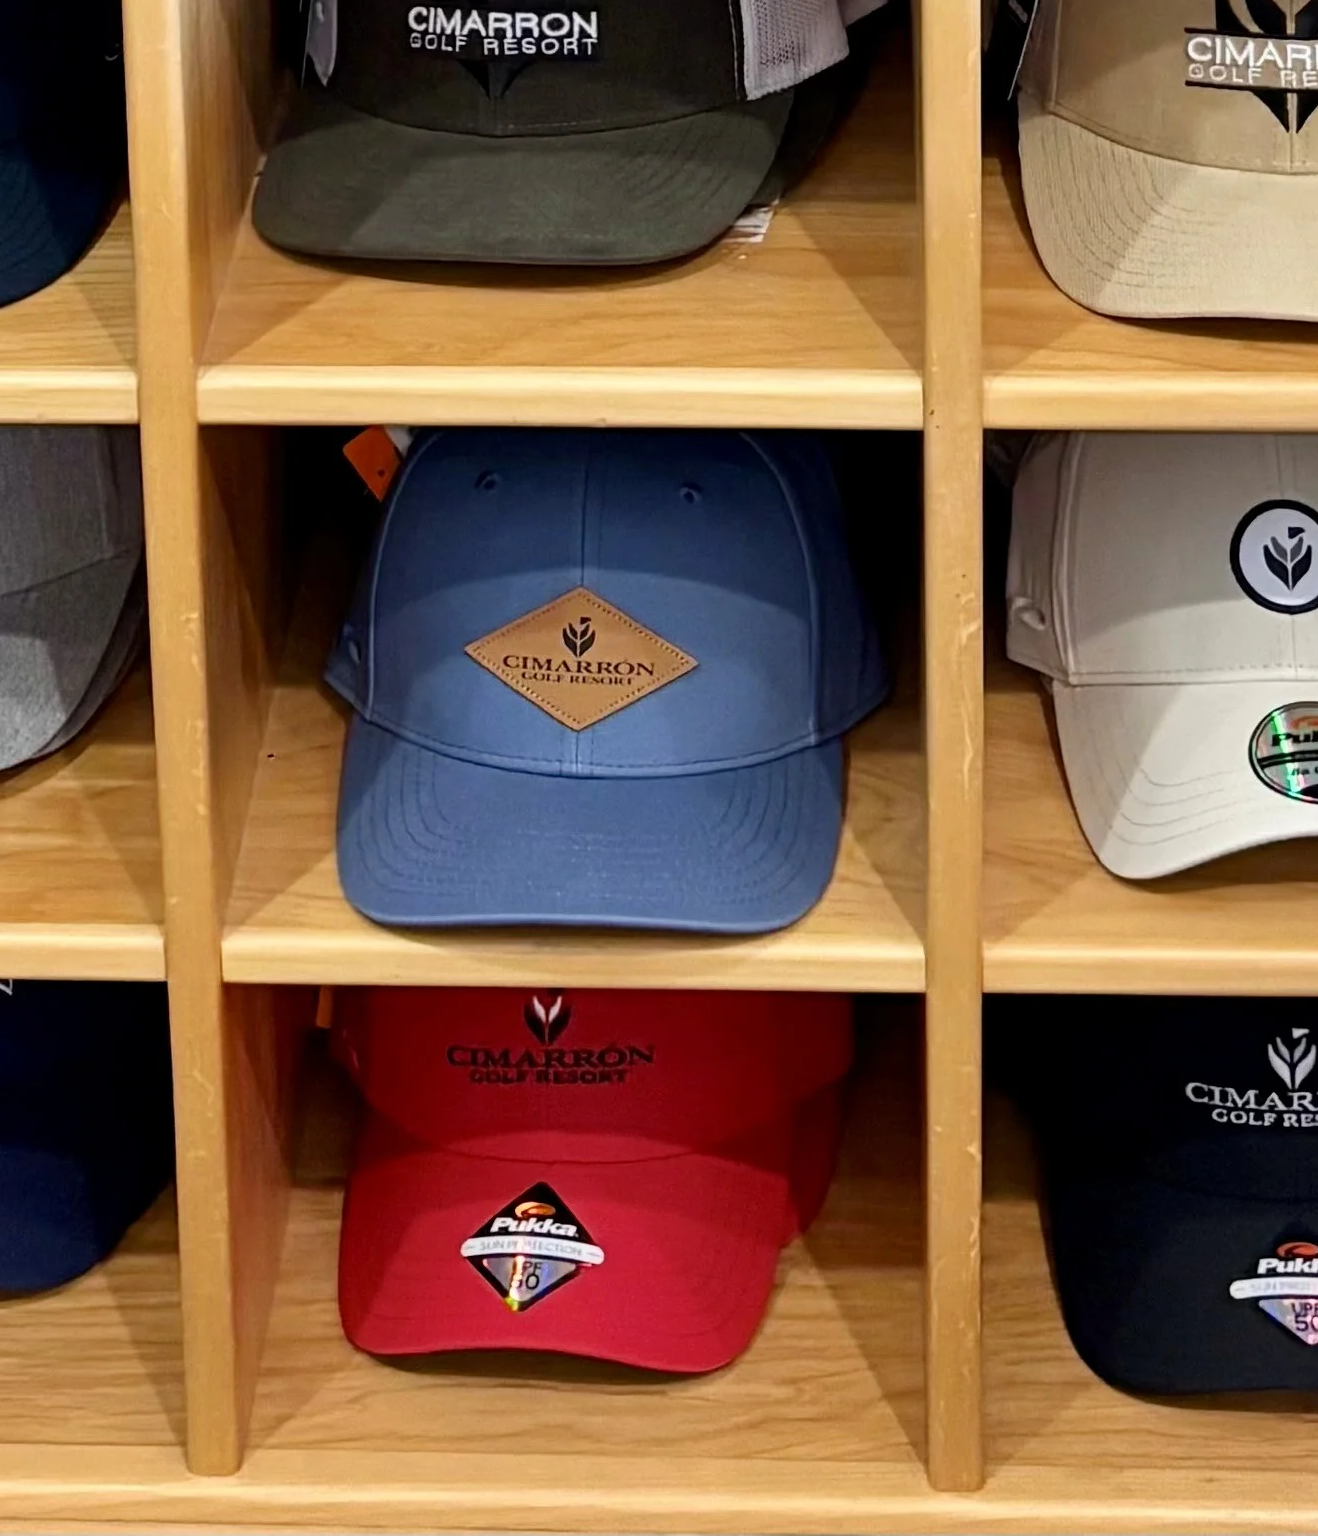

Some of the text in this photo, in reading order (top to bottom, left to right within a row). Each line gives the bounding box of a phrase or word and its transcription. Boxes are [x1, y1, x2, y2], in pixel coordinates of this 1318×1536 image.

[406, 6, 599, 40] CIMARRON
[409, 32, 598, 56] GOLF RESORT
[1187, 62, 1262, 85] GOLF
[502, 652, 656, 678] CIMARRÓN
[521, 671, 635, 687] GOLF RESORT
[469, 1067, 628, 1086] GOLF RESORT
[1210, 1109, 1267, 1127] GOLF
[490, 1217, 578, 1237] Pukka
